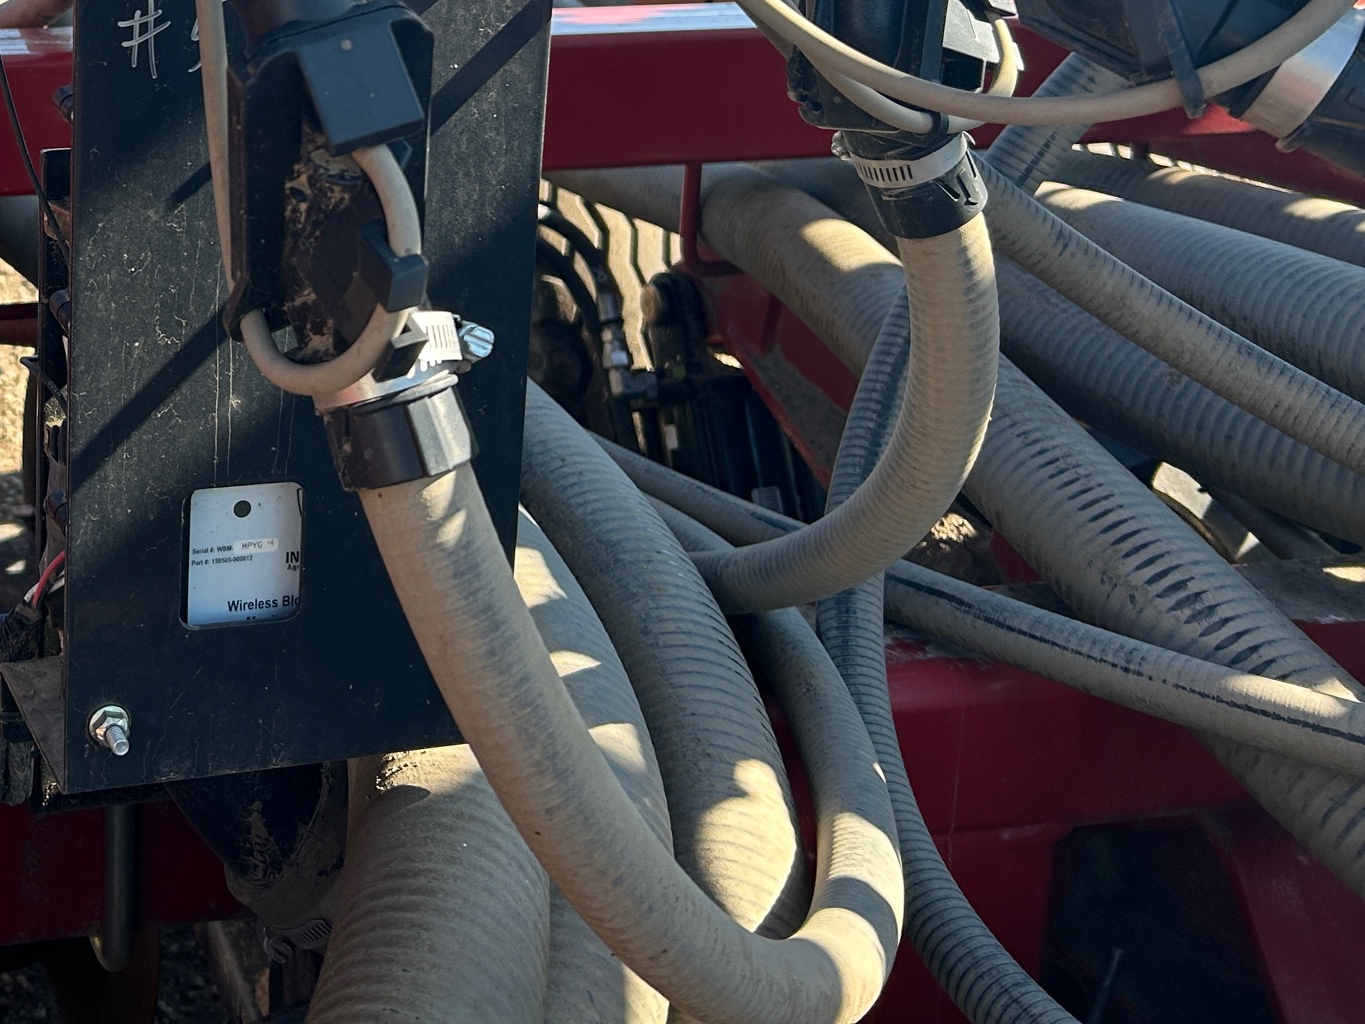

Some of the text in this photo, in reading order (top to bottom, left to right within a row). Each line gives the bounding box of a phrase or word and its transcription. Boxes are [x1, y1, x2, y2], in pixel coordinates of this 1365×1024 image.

[241, 541, 263, 549] HPYG
[192, 546, 209, 554] Serial
[227, 598, 279, 612] Wireless
